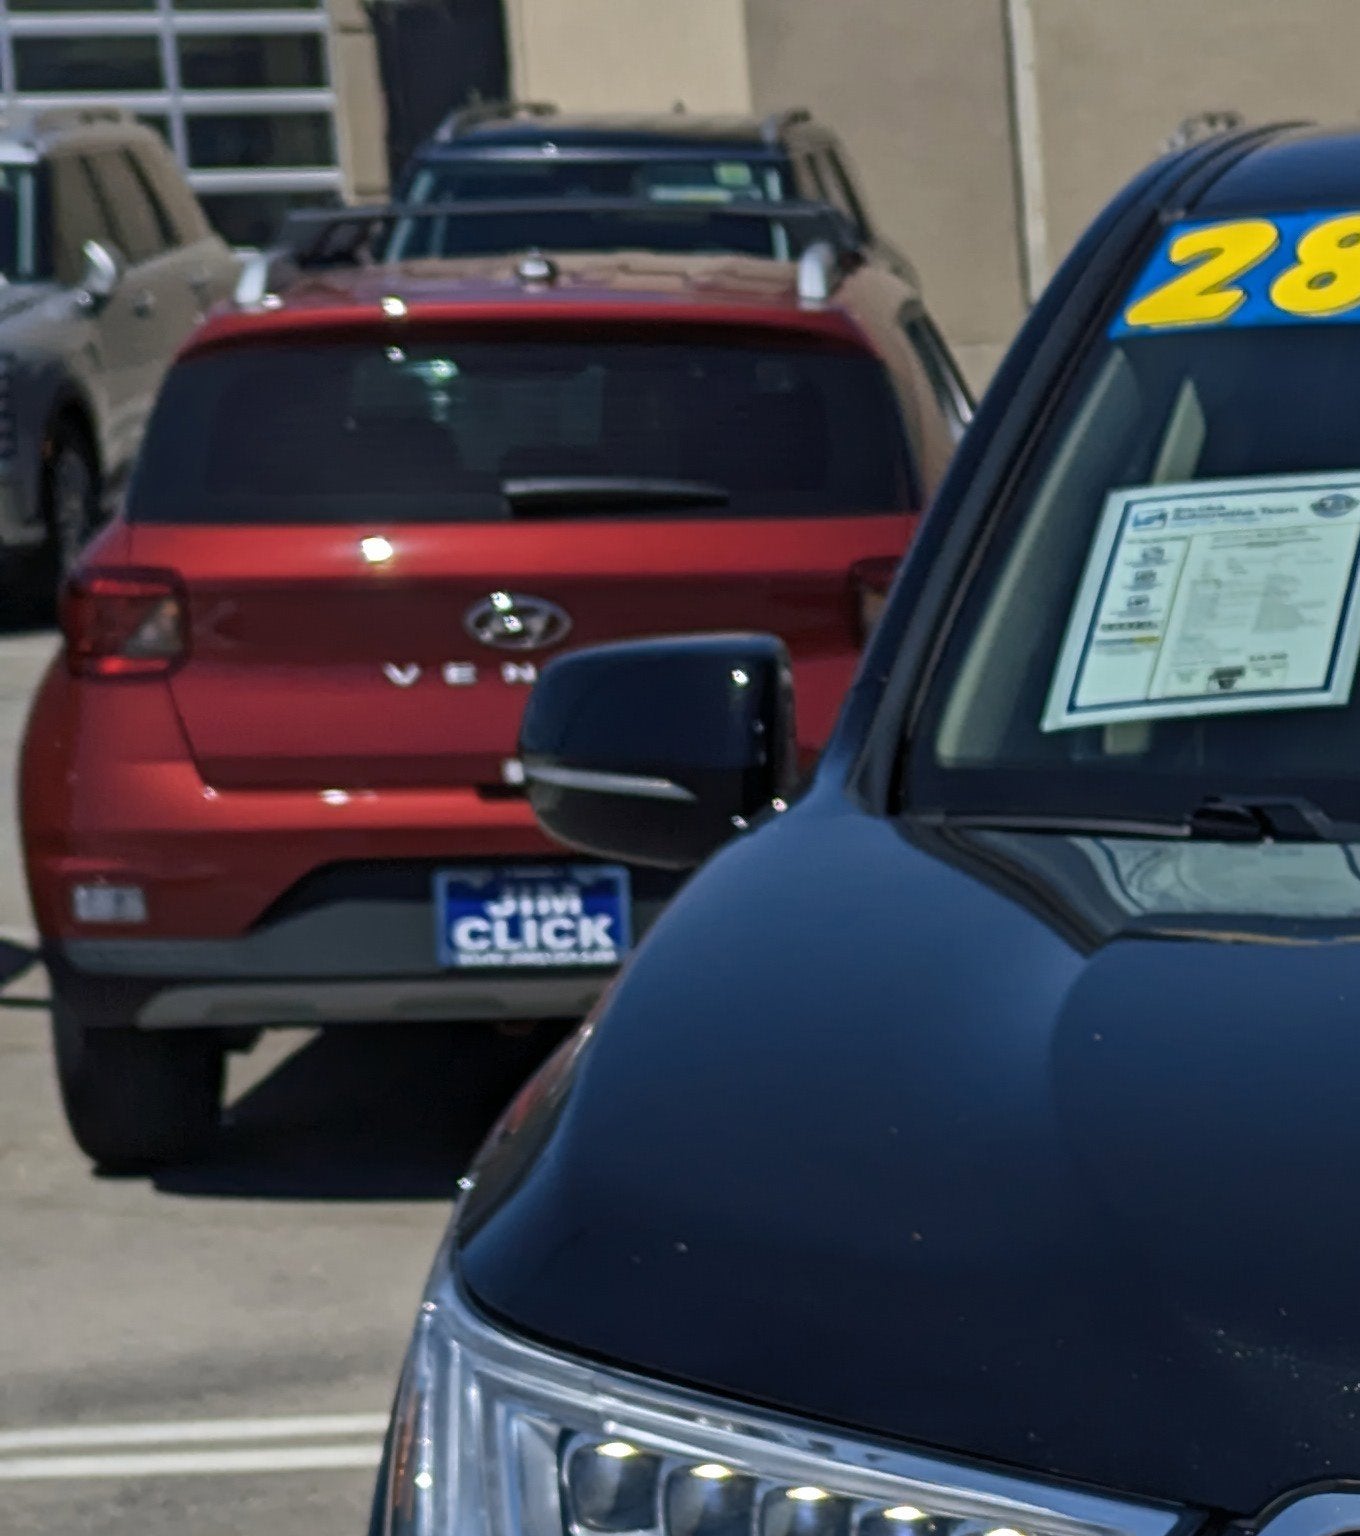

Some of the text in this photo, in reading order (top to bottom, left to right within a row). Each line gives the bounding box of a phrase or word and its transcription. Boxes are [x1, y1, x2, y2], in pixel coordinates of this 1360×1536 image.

[383, 661, 537, 687] VEN
[484, 886, 583, 917] JIM
[453, 914, 615, 951] CLICK
